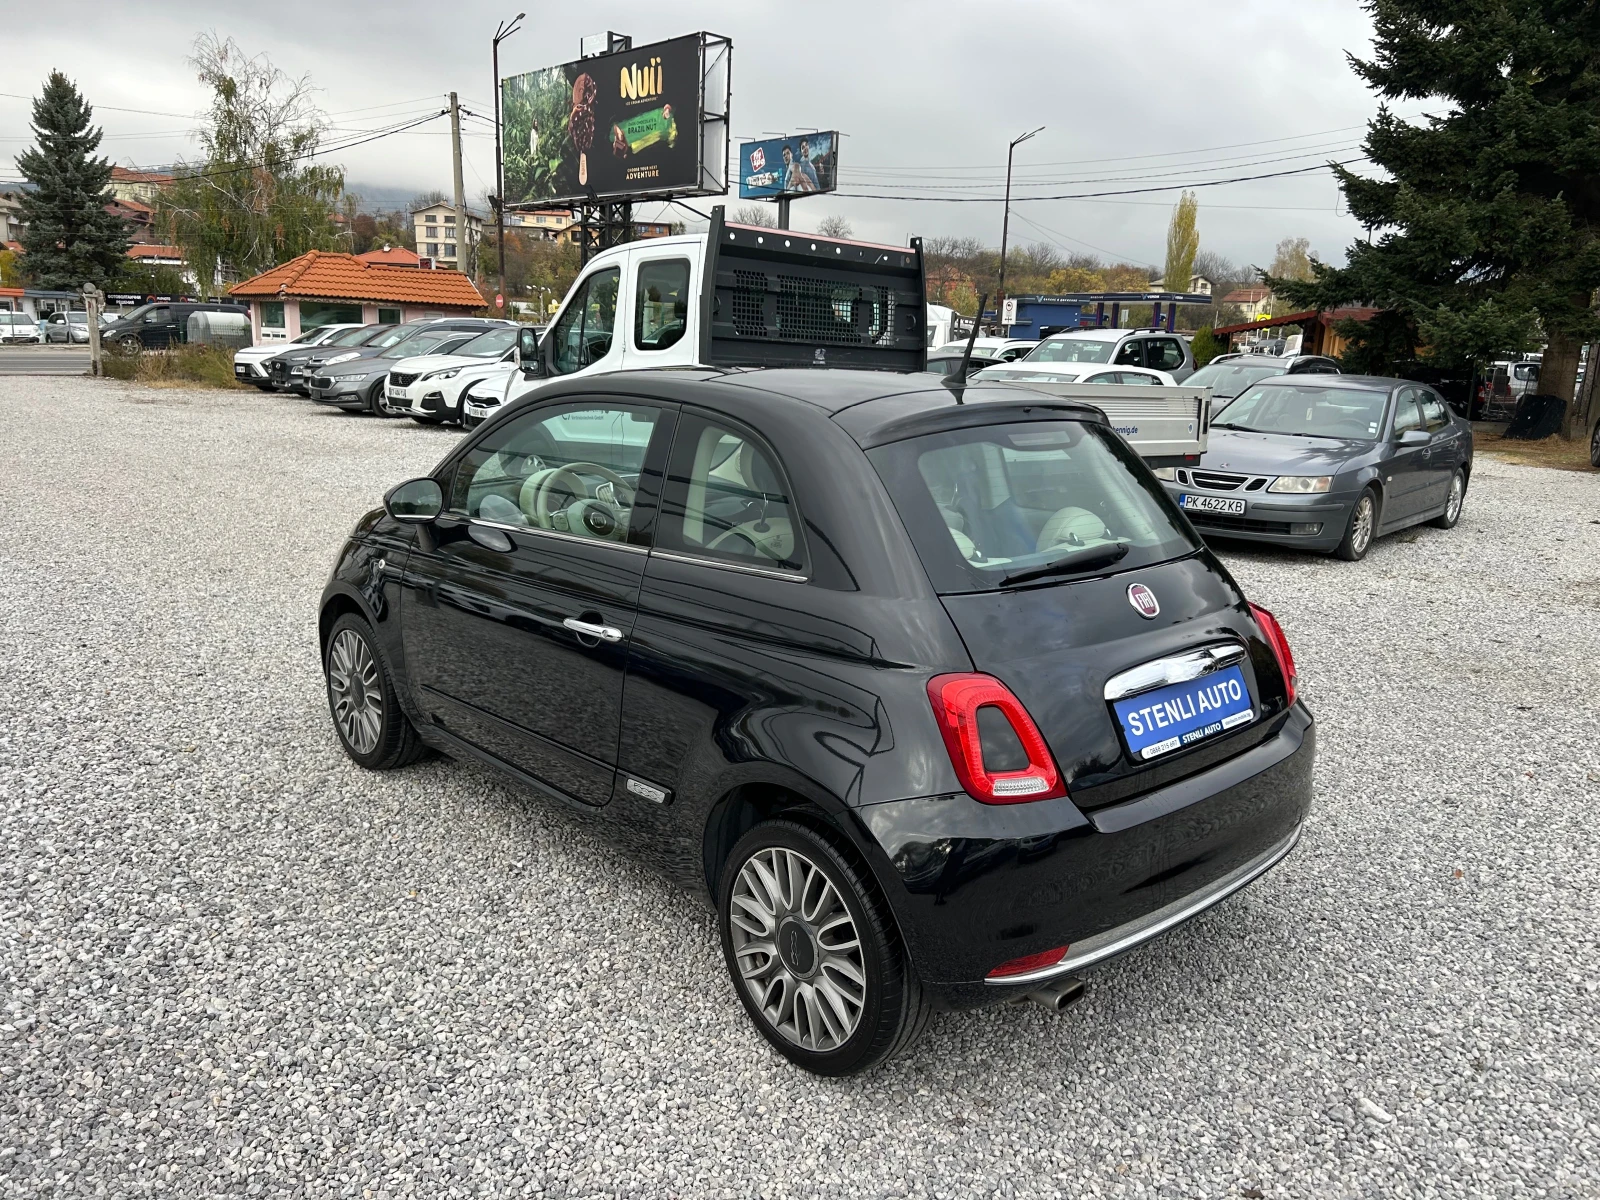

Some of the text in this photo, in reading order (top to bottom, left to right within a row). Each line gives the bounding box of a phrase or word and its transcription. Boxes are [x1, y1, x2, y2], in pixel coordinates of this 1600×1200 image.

[628, 123, 657, 134] BRAZIL NUT
[625, 169, 659, 180] ADVENTURE
[1186, 496, 1199, 508] PK
[1201, 498, 1227, 511] 4622
[1228, 501, 1243, 512] KB
[1127, 679, 1242, 736] STENLI AUTO
[1182, 729, 1204, 744] STENLI
[1204, 722, 1222, 736] AUTO
